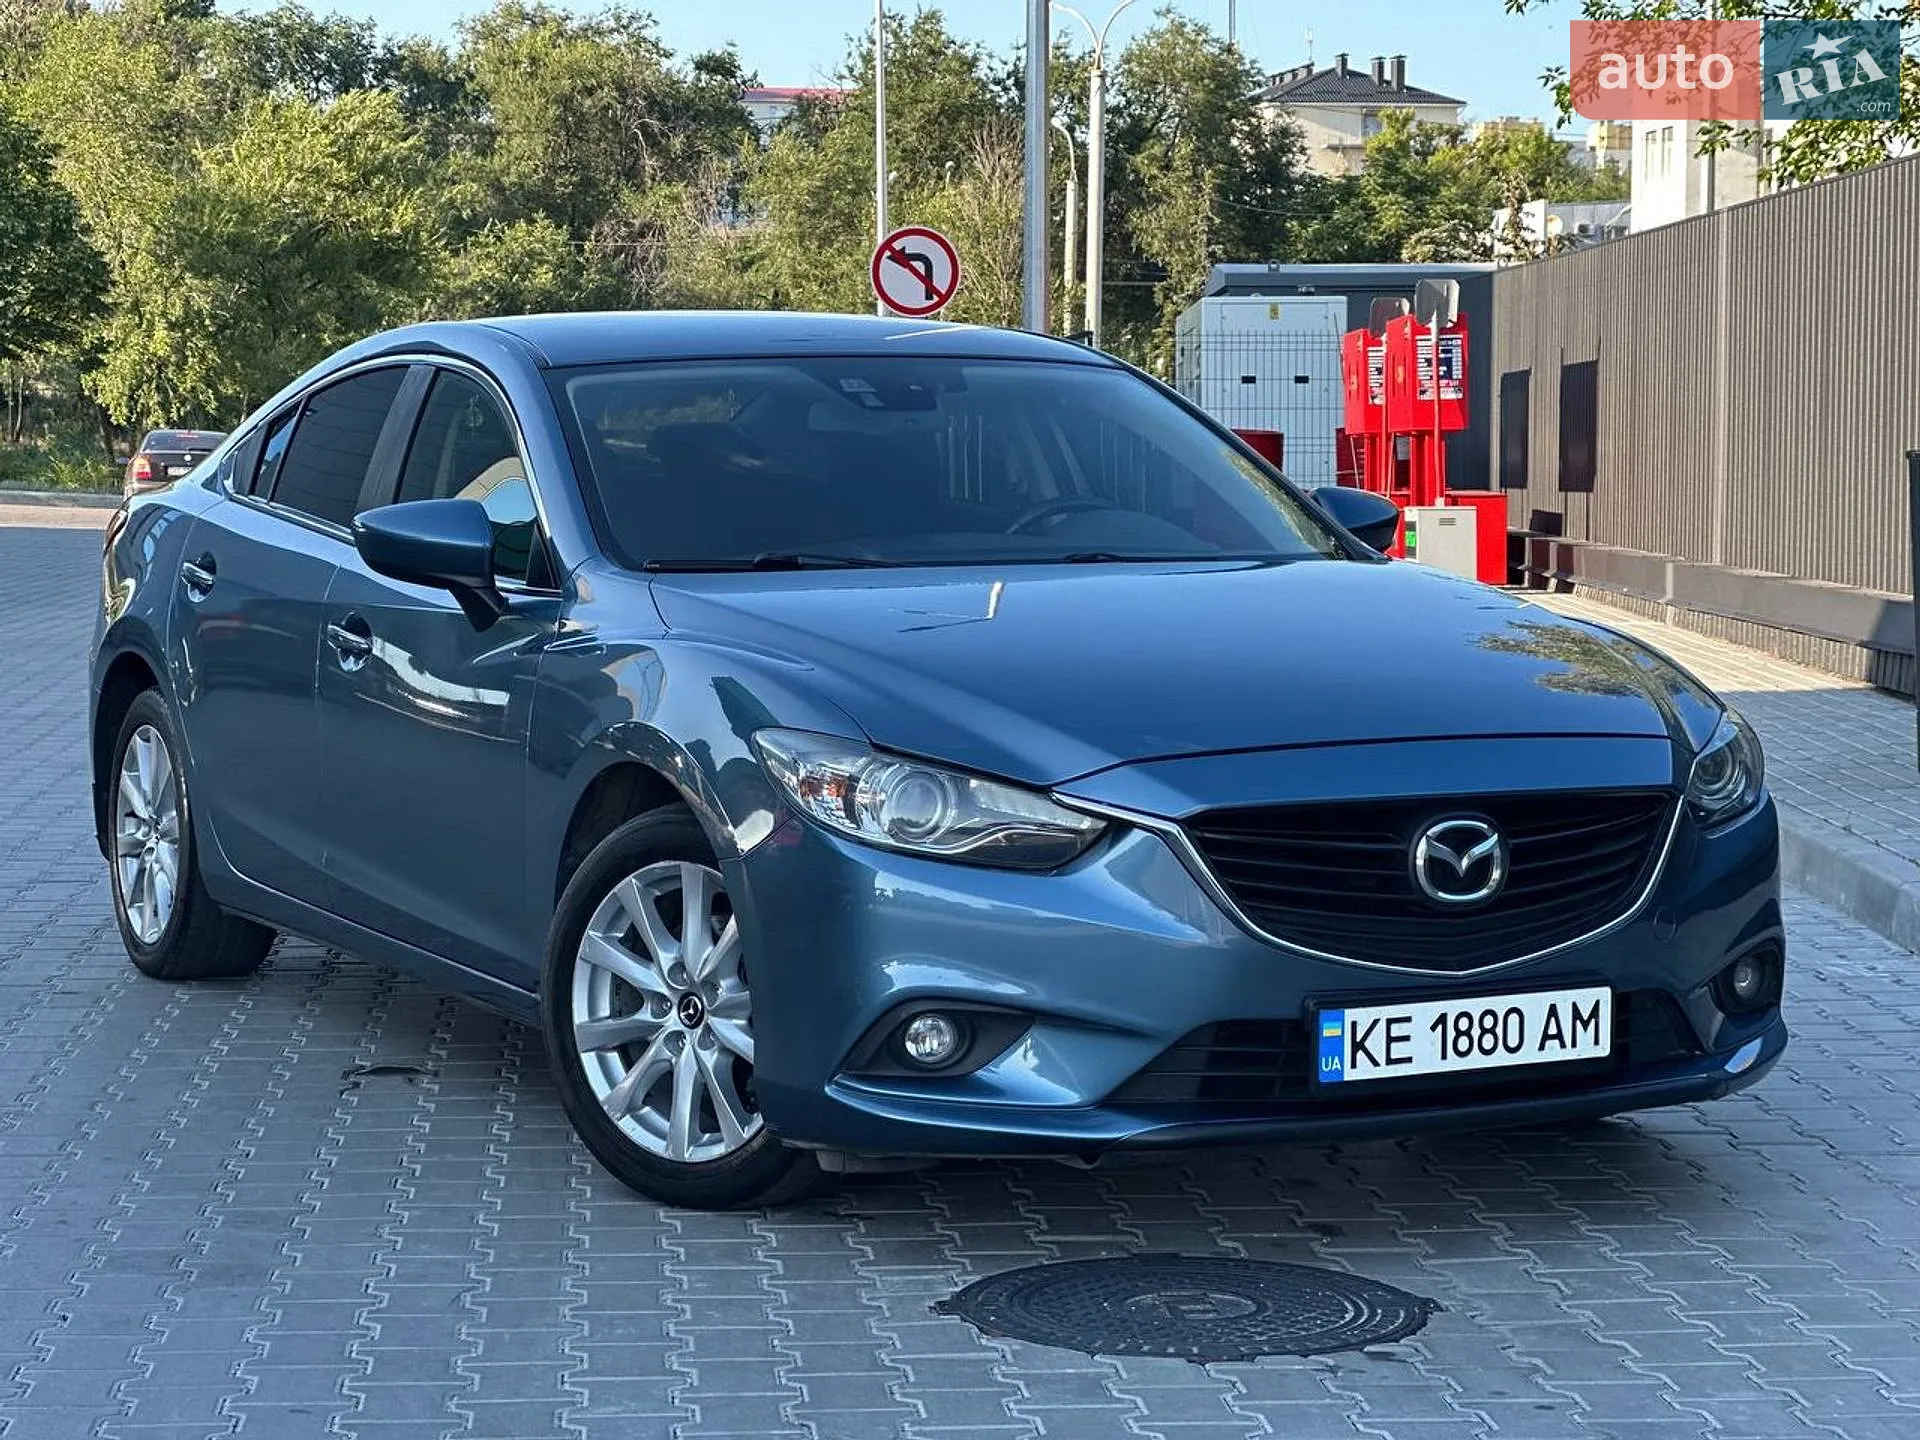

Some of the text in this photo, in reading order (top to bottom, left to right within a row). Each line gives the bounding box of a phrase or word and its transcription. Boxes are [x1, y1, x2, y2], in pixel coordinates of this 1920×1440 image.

[1350, 999, 1601, 1069] KE 1880 AM
[1321, 1057, 1342, 1072] UA
